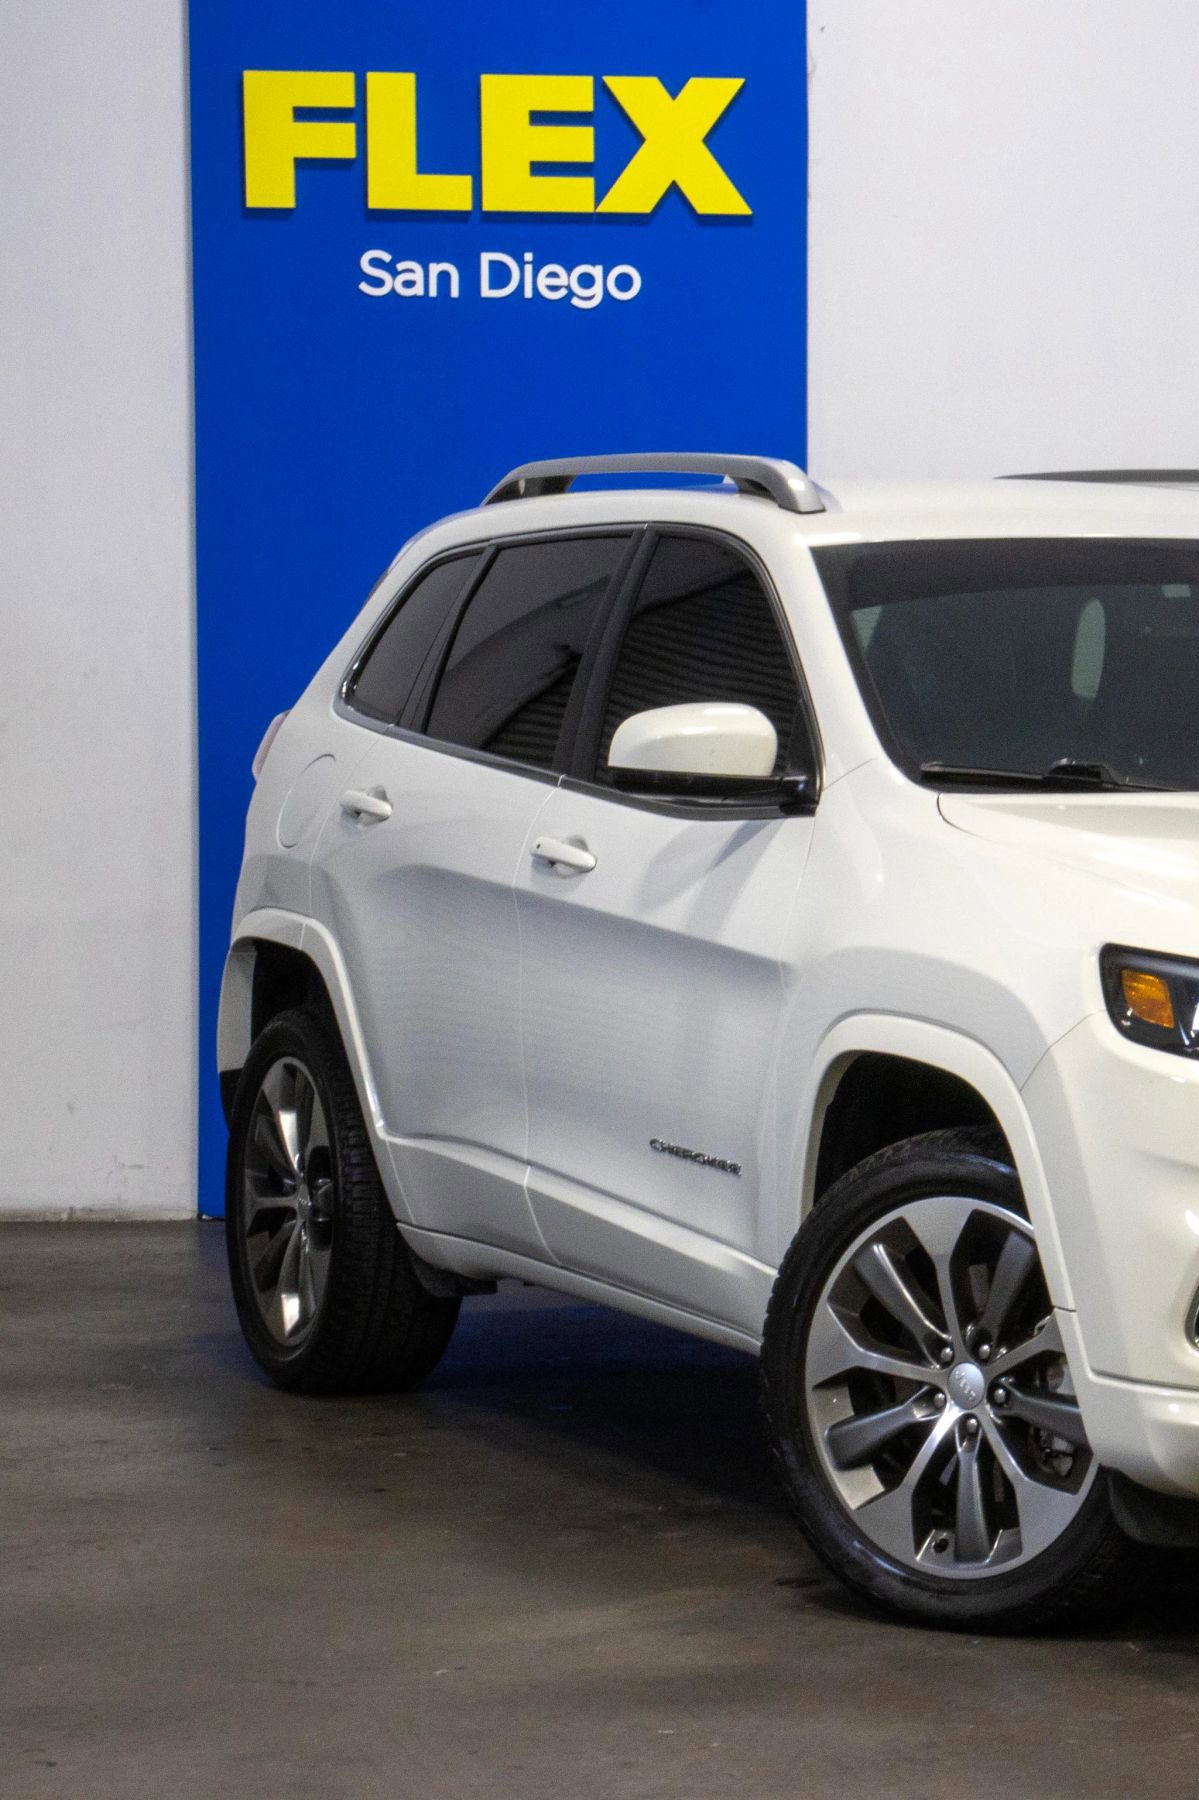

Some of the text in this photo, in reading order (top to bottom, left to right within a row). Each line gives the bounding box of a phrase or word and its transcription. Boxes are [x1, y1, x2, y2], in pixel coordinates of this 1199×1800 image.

[242, 70, 753, 215] FLEX
[358, 249, 642, 309] San Diego
